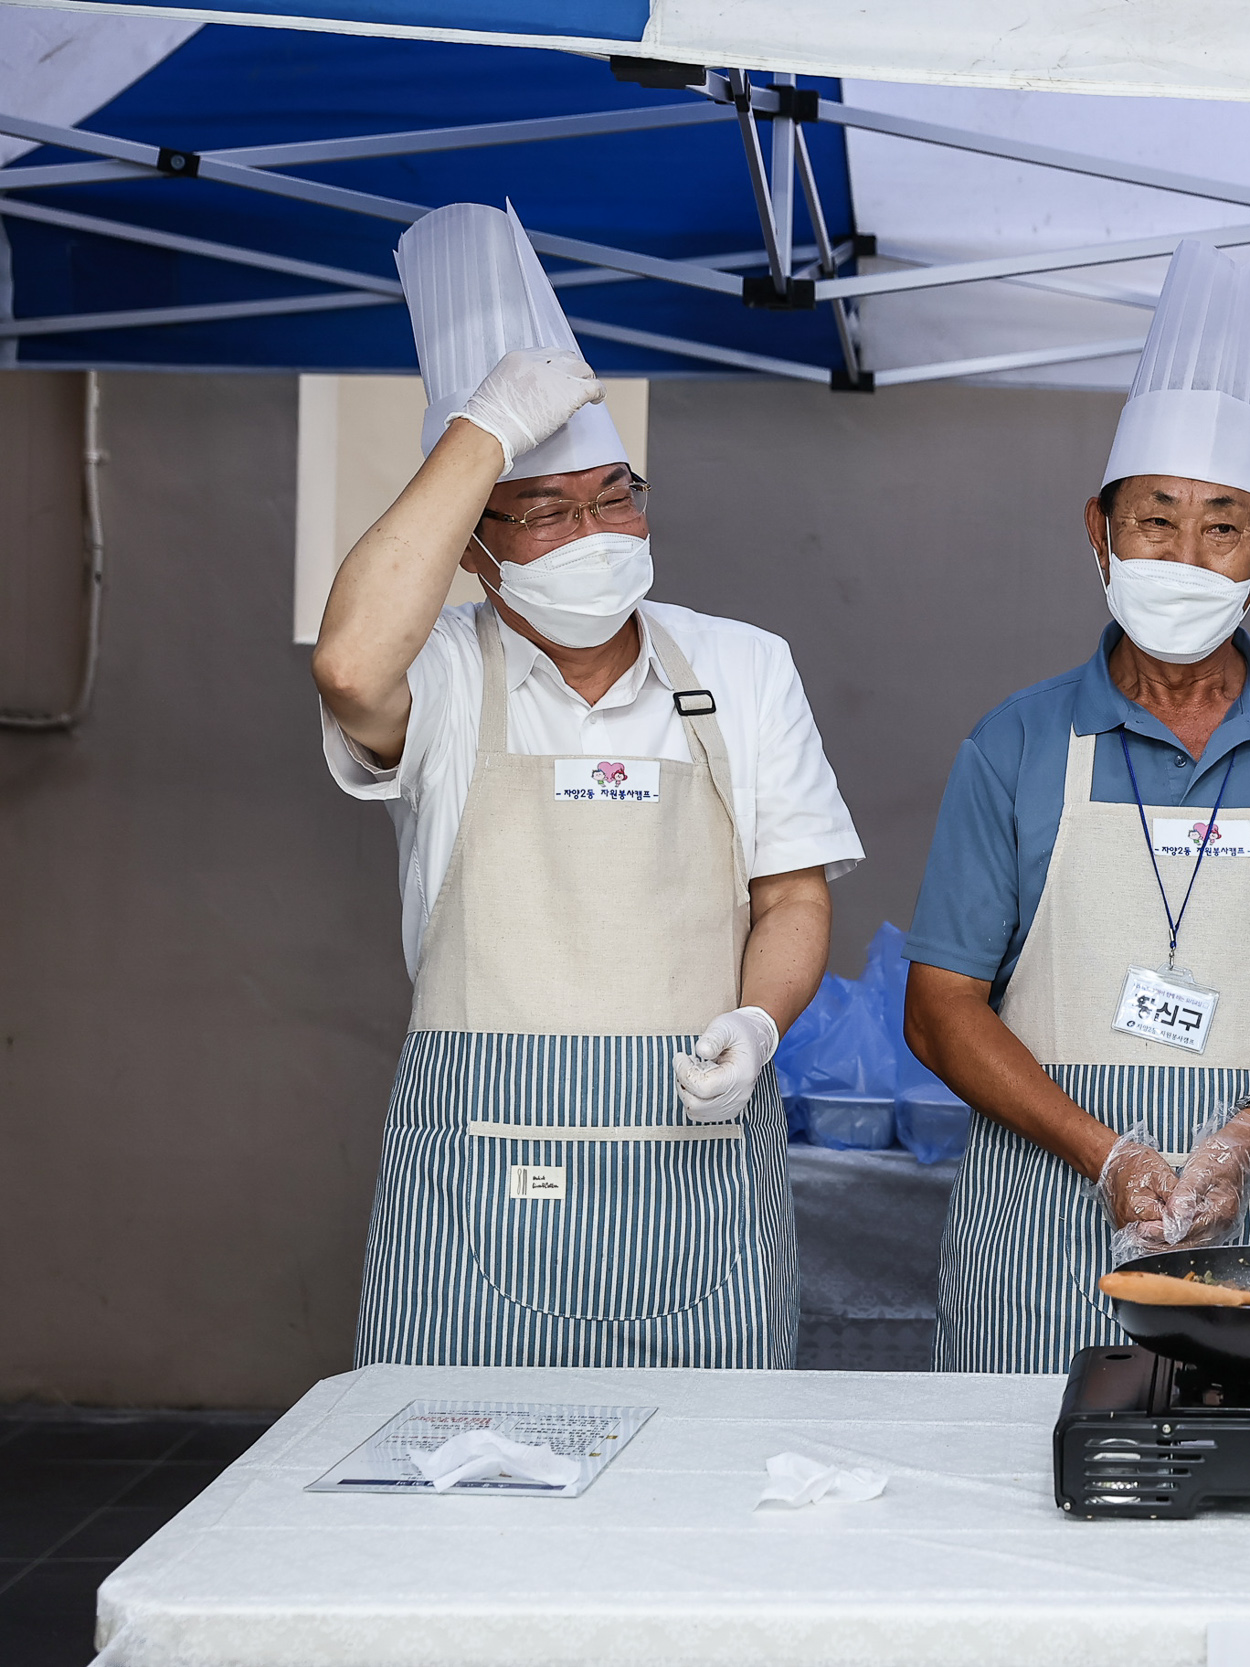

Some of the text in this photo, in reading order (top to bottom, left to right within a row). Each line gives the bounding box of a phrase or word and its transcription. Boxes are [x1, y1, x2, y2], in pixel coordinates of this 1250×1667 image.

[563, 788, 651, 801] 자양2동 자원봉사캠프
[1161, 846, 1192, 857] 자양2동
